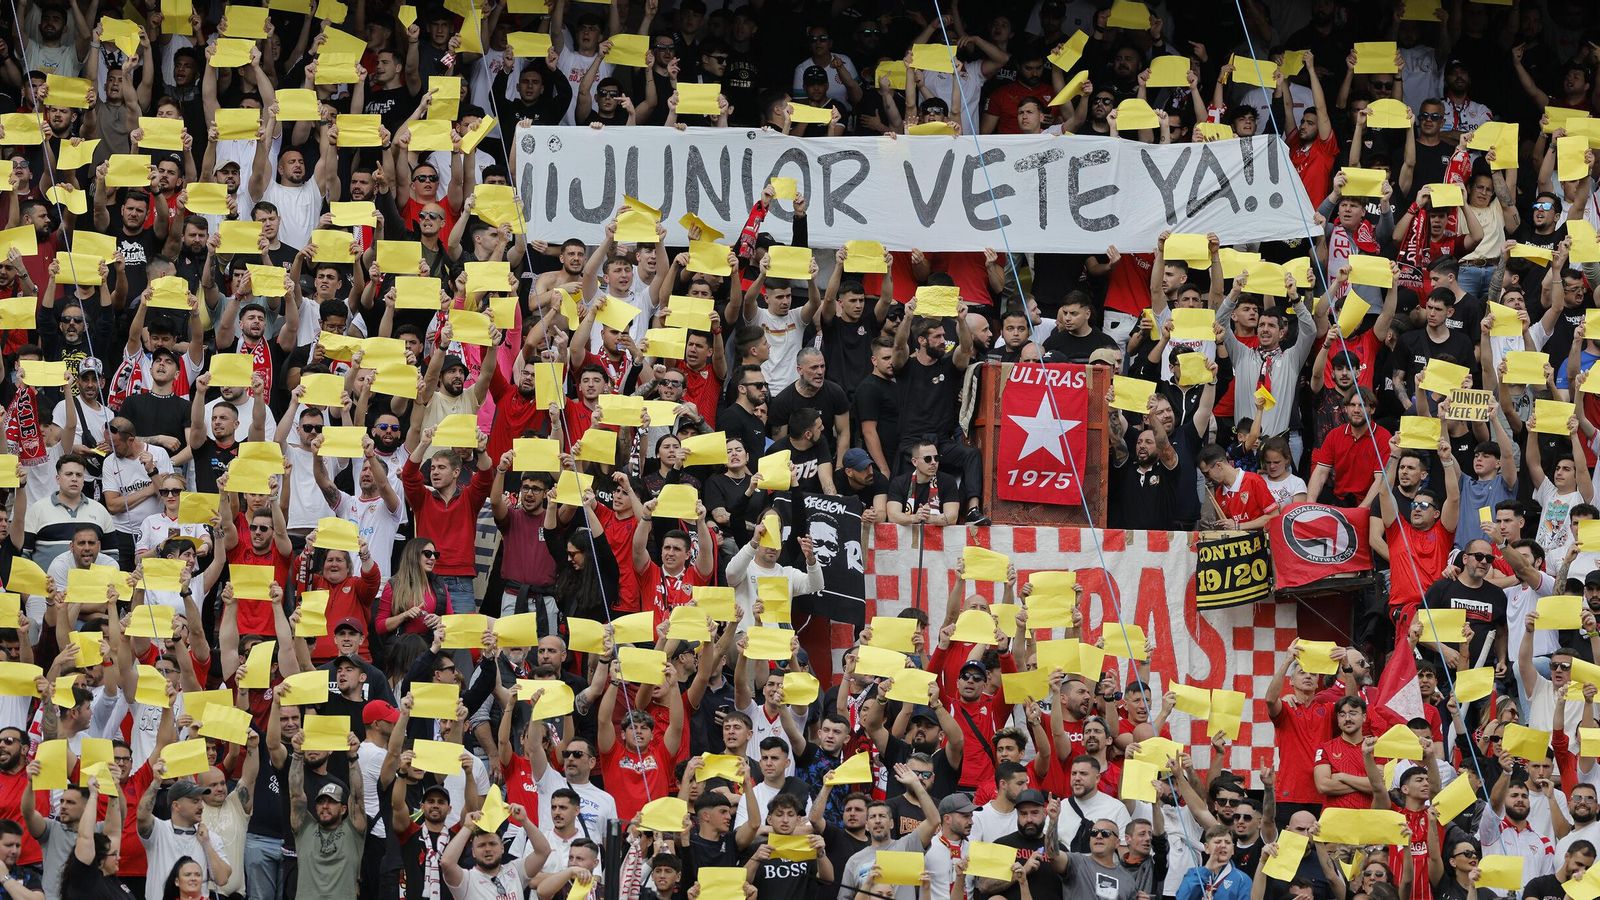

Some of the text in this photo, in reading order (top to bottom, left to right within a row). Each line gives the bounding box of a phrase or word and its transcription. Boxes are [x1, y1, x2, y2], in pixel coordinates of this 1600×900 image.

[903, 148, 1120, 231] VETE
[1140, 134, 1284, 225] YA!!
[1010, 365, 1087, 389] ULTRAS
[1450, 391, 1490, 405] JUNIOR
[1448, 406, 1488, 420] VETE YA
[1007, 468, 1073, 490] 1975
[1198, 558, 1267, 592] 19/20
[763, 862, 808, 879] BOSS
